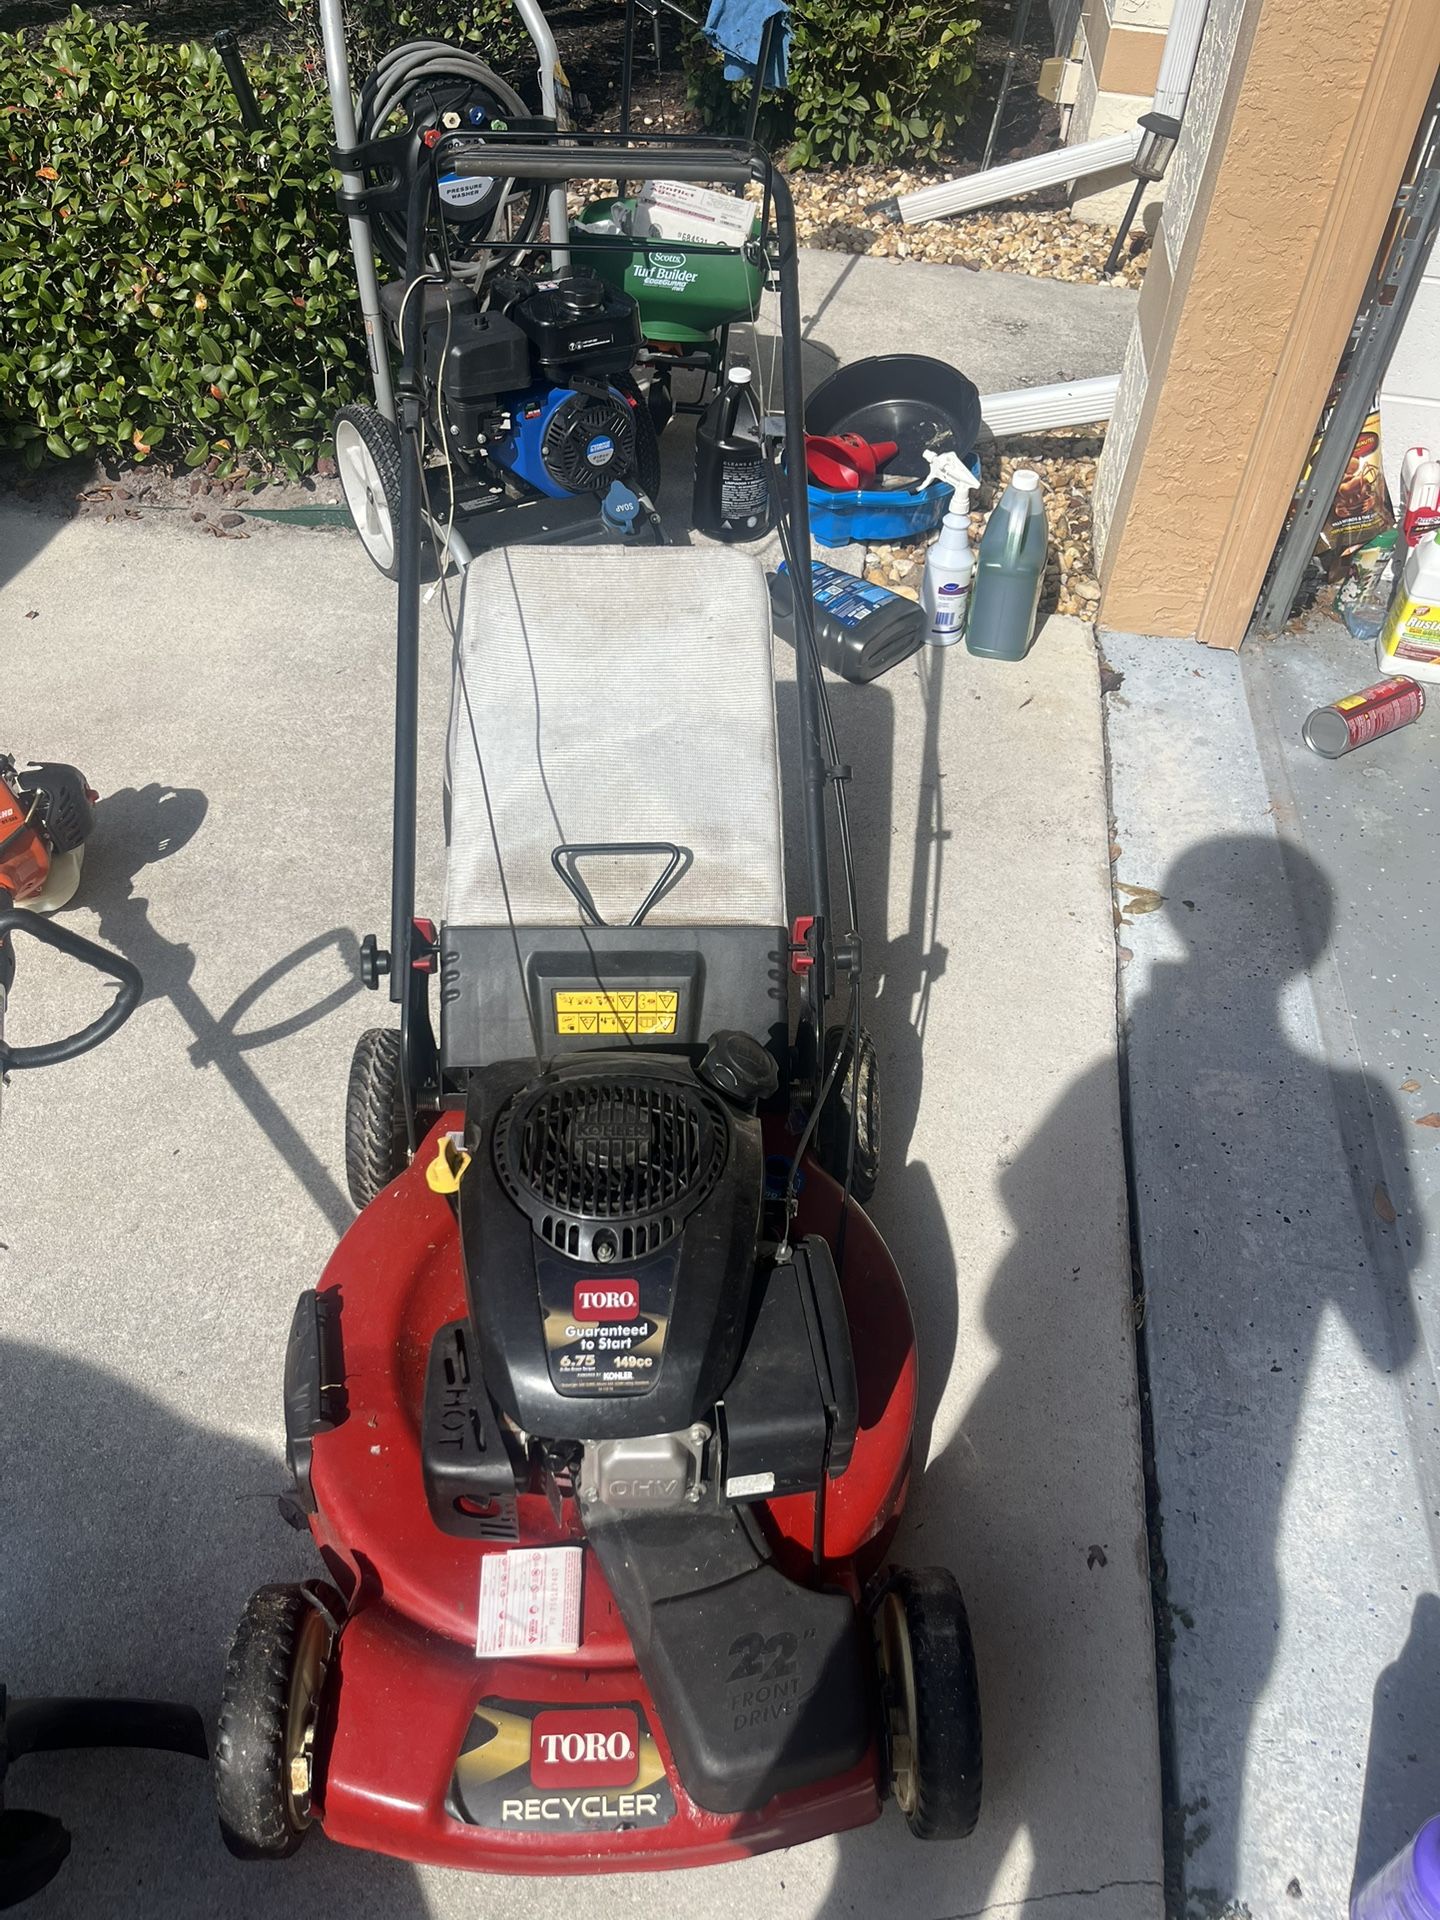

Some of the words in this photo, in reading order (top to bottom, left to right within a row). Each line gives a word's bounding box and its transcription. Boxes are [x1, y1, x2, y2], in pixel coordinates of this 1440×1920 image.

[446, 183, 483, 194] PRESSURE
[451, 189, 480, 199] WASHER
[654, 252, 681, 263] Scotts
[633, 264, 656, 277] Turf
[656, 268, 698, 283] Builder
[615, 502, 634, 513] SOAP
[578, 1291, 635, 1309] TORO
[565, 1322, 648, 1337] Guaranteed
[580, 1338, 595, 1351] to
[598, 1337, 632, 1350] Start
[559, 1353, 596, 1367] 6.75
[613, 1355, 653, 1369] 149cc
[603, 1371, 633, 1381] KOHLER
[438, 1388, 468, 1451] HOT
[609, 1479, 678, 1497] OHV
[731, 1679, 799, 1711] FRONT
[734, 1701, 793, 1732] DRIVE
[540, 1731, 631, 1764] TORO
[502, 1794, 657, 1821] RECYCLER
